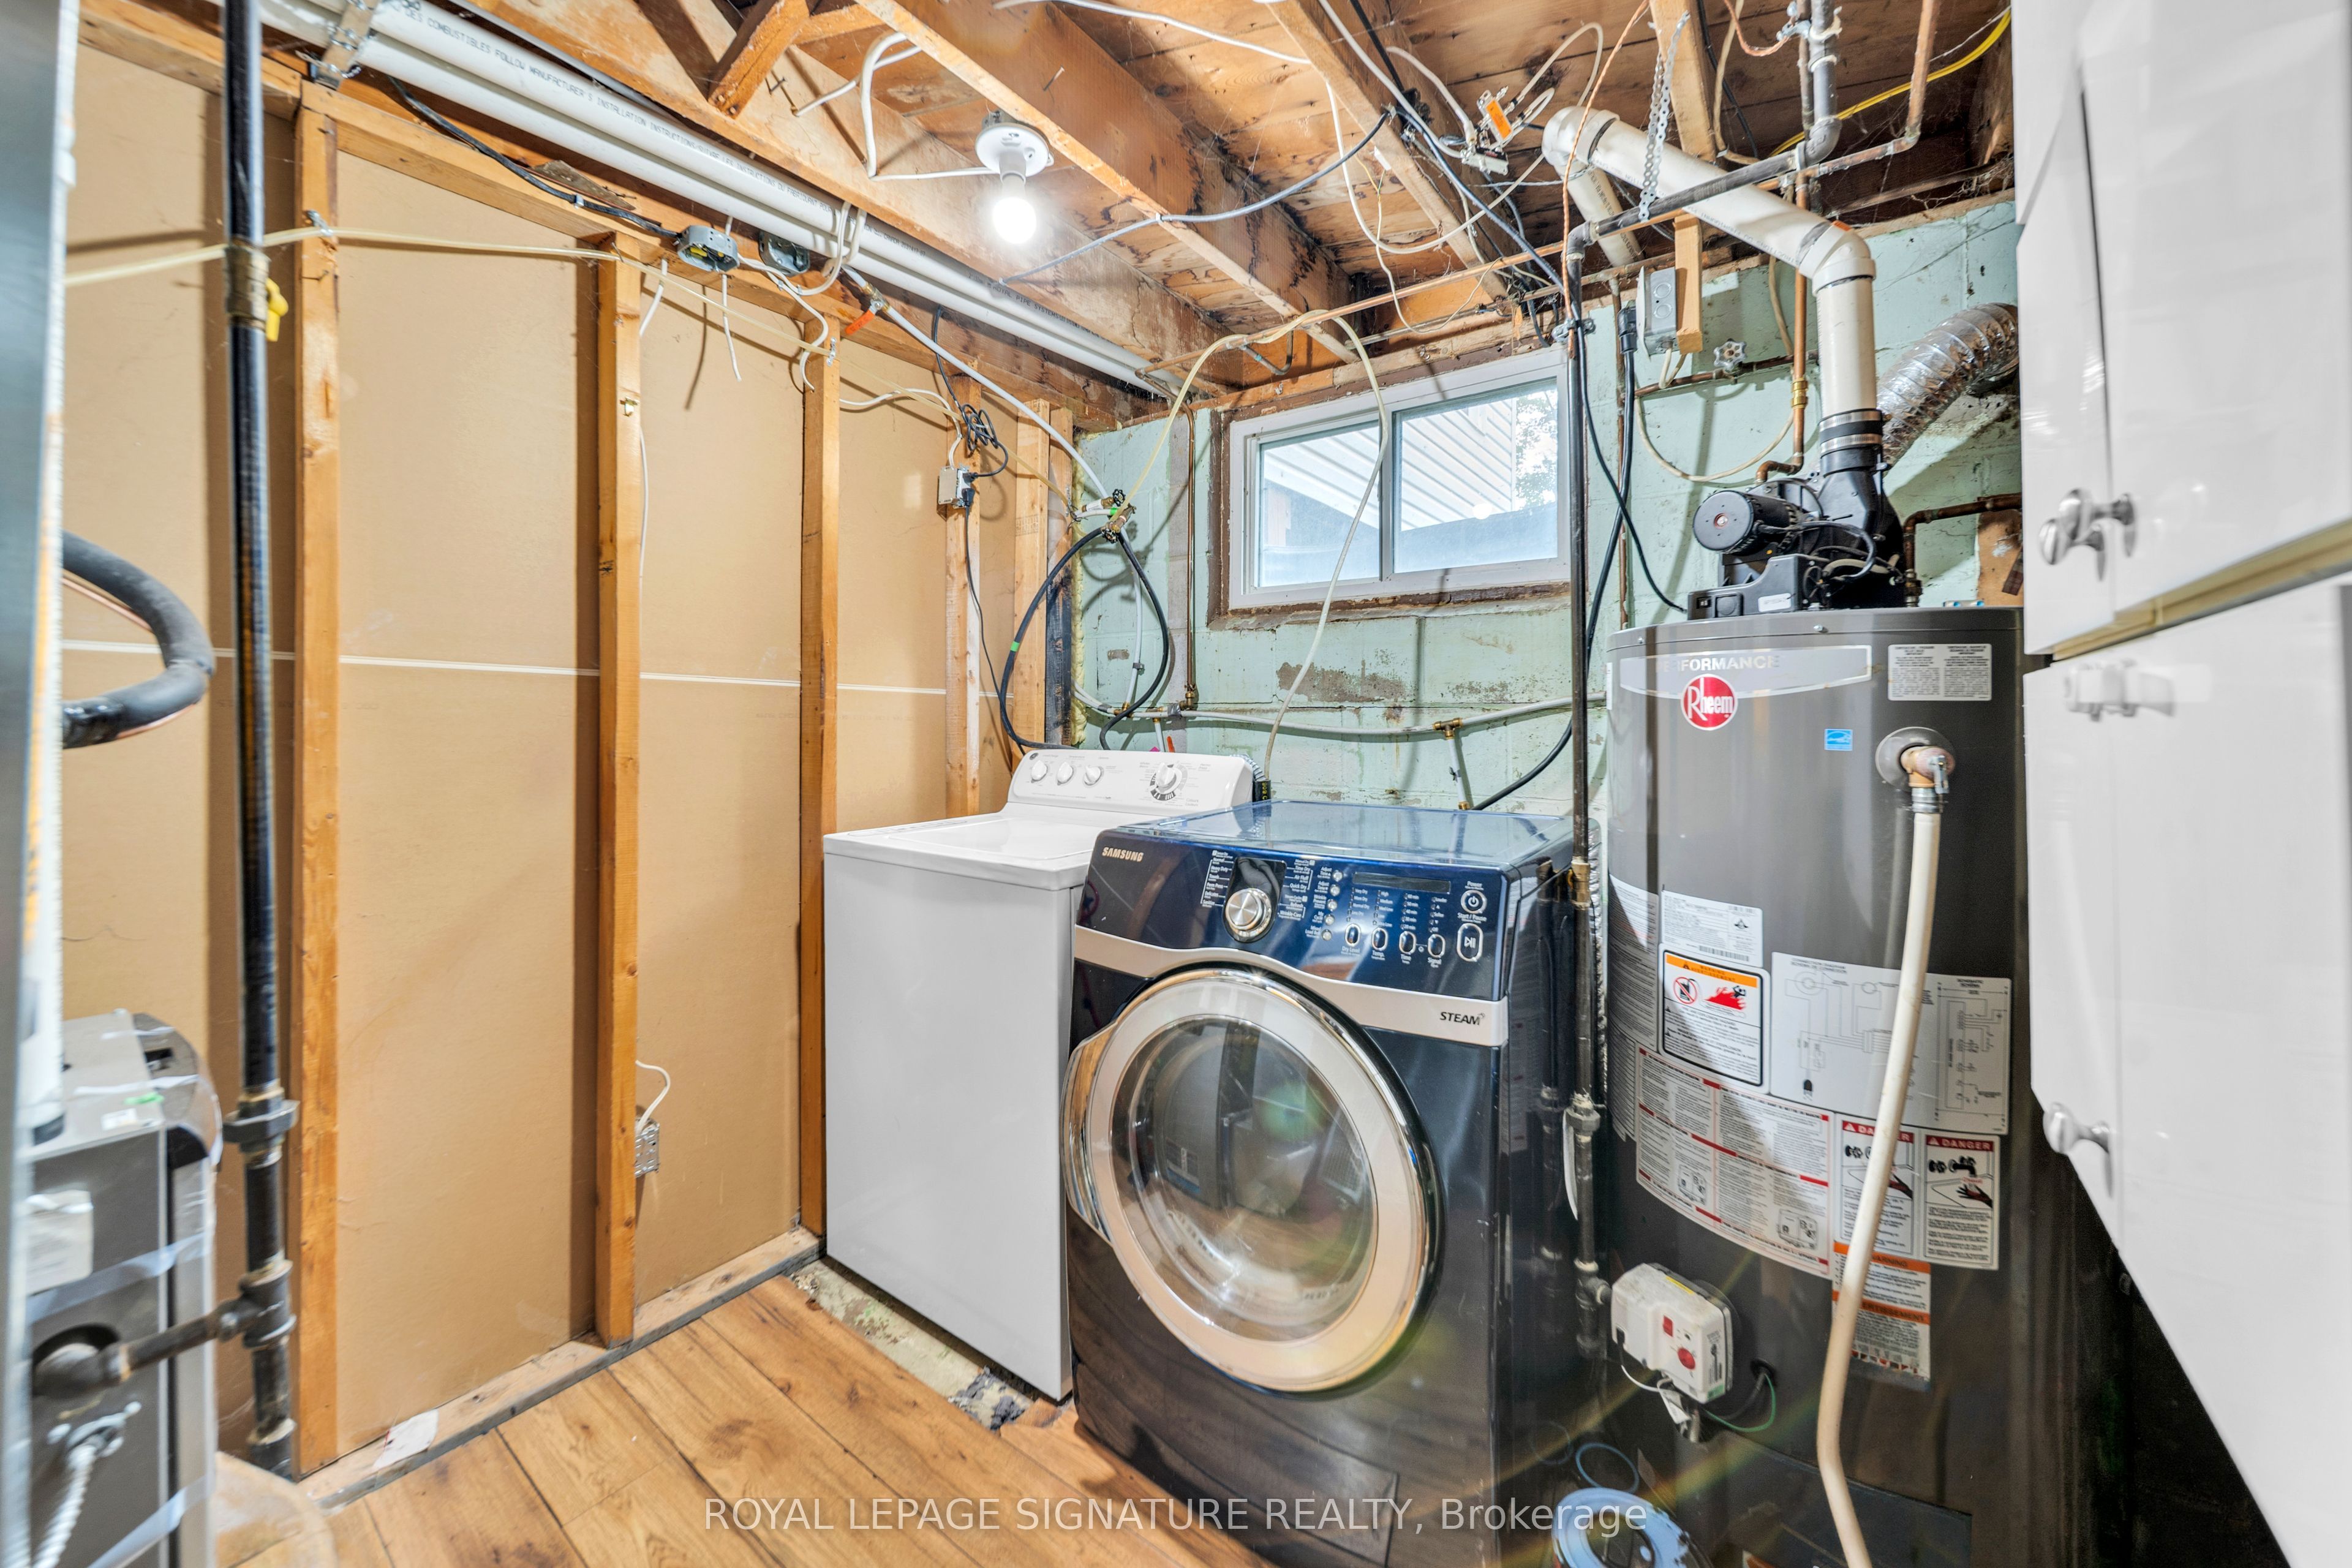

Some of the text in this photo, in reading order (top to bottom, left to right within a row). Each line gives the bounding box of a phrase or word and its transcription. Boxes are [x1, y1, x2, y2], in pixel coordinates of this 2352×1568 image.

[428, 17, 491, 54] COMBUSTIBLES
[495, 49, 526, 70] FOLLOW
[597, 98, 647, 127] INSTALLATION
[1016, 295, 1031, 307] PIPE
[1687, 677, 1733, 721] Rheem
[1102, 847, 1144, 862] SAMSUNG
[1440, 1011, 1480, 1025] STEAM
[1942, 1139, 1991, 1150] DANGER
